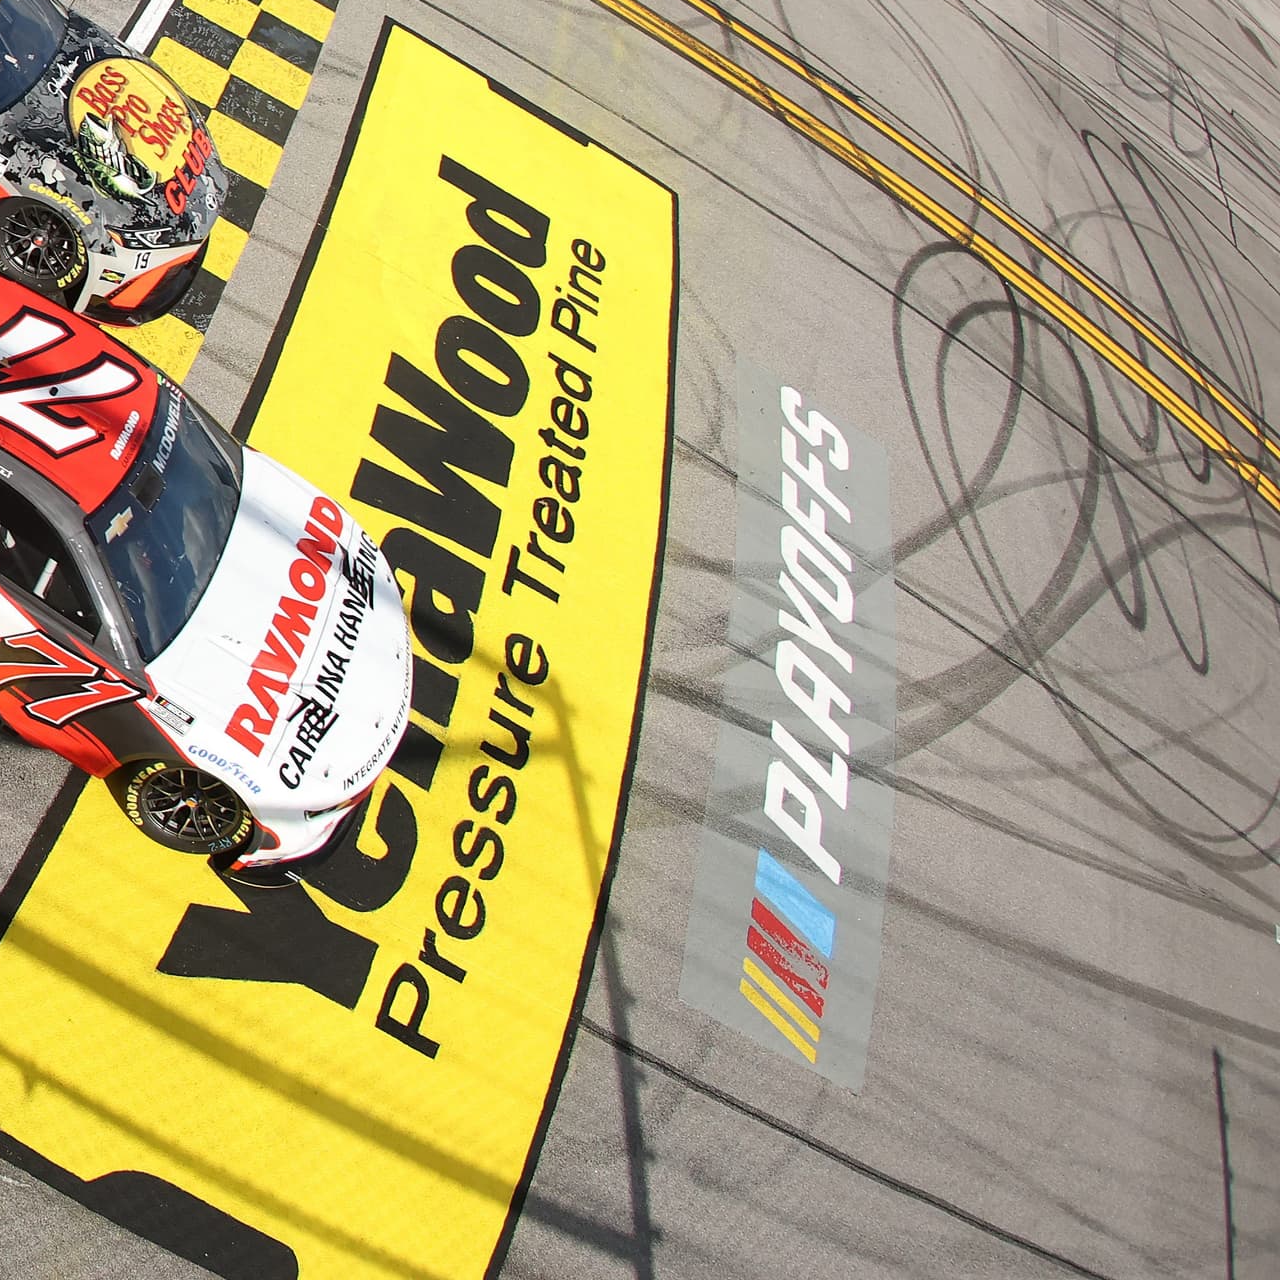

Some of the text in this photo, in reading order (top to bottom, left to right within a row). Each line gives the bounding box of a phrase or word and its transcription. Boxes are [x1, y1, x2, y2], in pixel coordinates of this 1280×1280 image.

[75, 65, 129, 118] Bass
[109, 93, 151, 138] Pro
[138, 96, 188, 160] Shops
[163, 127, 213, 216] CLUB
[28, 182, 92, 226] GOODYEAR
[55, 226, 86, 289] OODYEAR
[133, 251, 152, 271] 19
[109, 409, 140, 461] RAYMOND
[152, 391, 184, 474] MCDOWELL
[224, 495, 345, 758] RAYMOND
[376, 235, 610, 1058] Pressure Treated Pine
[762, 384, 855, 886] PLAYOFFS
[187, 743, 263, 796] GOODYEAR
[342, 703, 408, 792] INTEGRATE WITH
[126, 761, 168, 827] GOODYEAR
[231, 808, 253, 845] EAGLE
